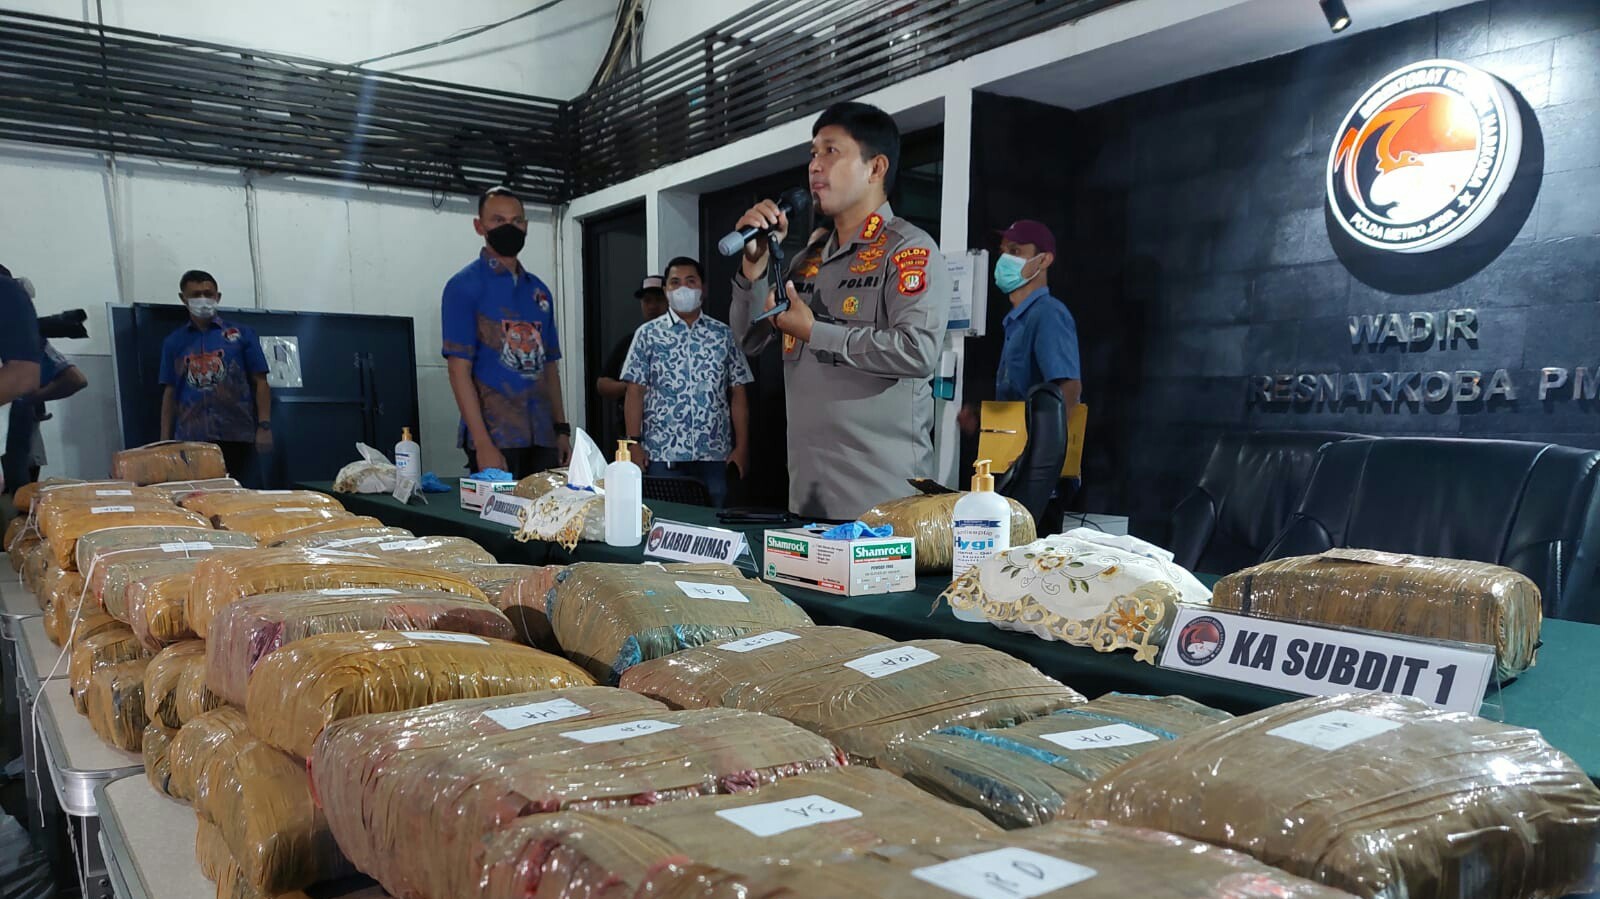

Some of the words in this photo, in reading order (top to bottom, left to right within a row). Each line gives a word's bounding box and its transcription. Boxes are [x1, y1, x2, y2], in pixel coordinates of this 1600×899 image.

[1350, 211, 1384, 240] POLDA
[1382, 223, 1427, 241] METRO
[894, 248, 927, 262] POLDA
[837, 275, 879, 289] POLRI
[1349, 308, 1479, 345] WADIR
[1252, 368, 1517, 403] RESNARKOBA
[660, 530, 693, 553] KABID
[690, 535, 731, 561] HUMAS
[767, 536, 807, 553] Shamrock
[855, 545, 908, 558] Shamrock
[954, 536, 994, 551] Hygi
[1228, 630, 1278, 672] KA
[1281, 638, 1429, 697] SUBDIT
[1435, 663, 1458, 705] 1
